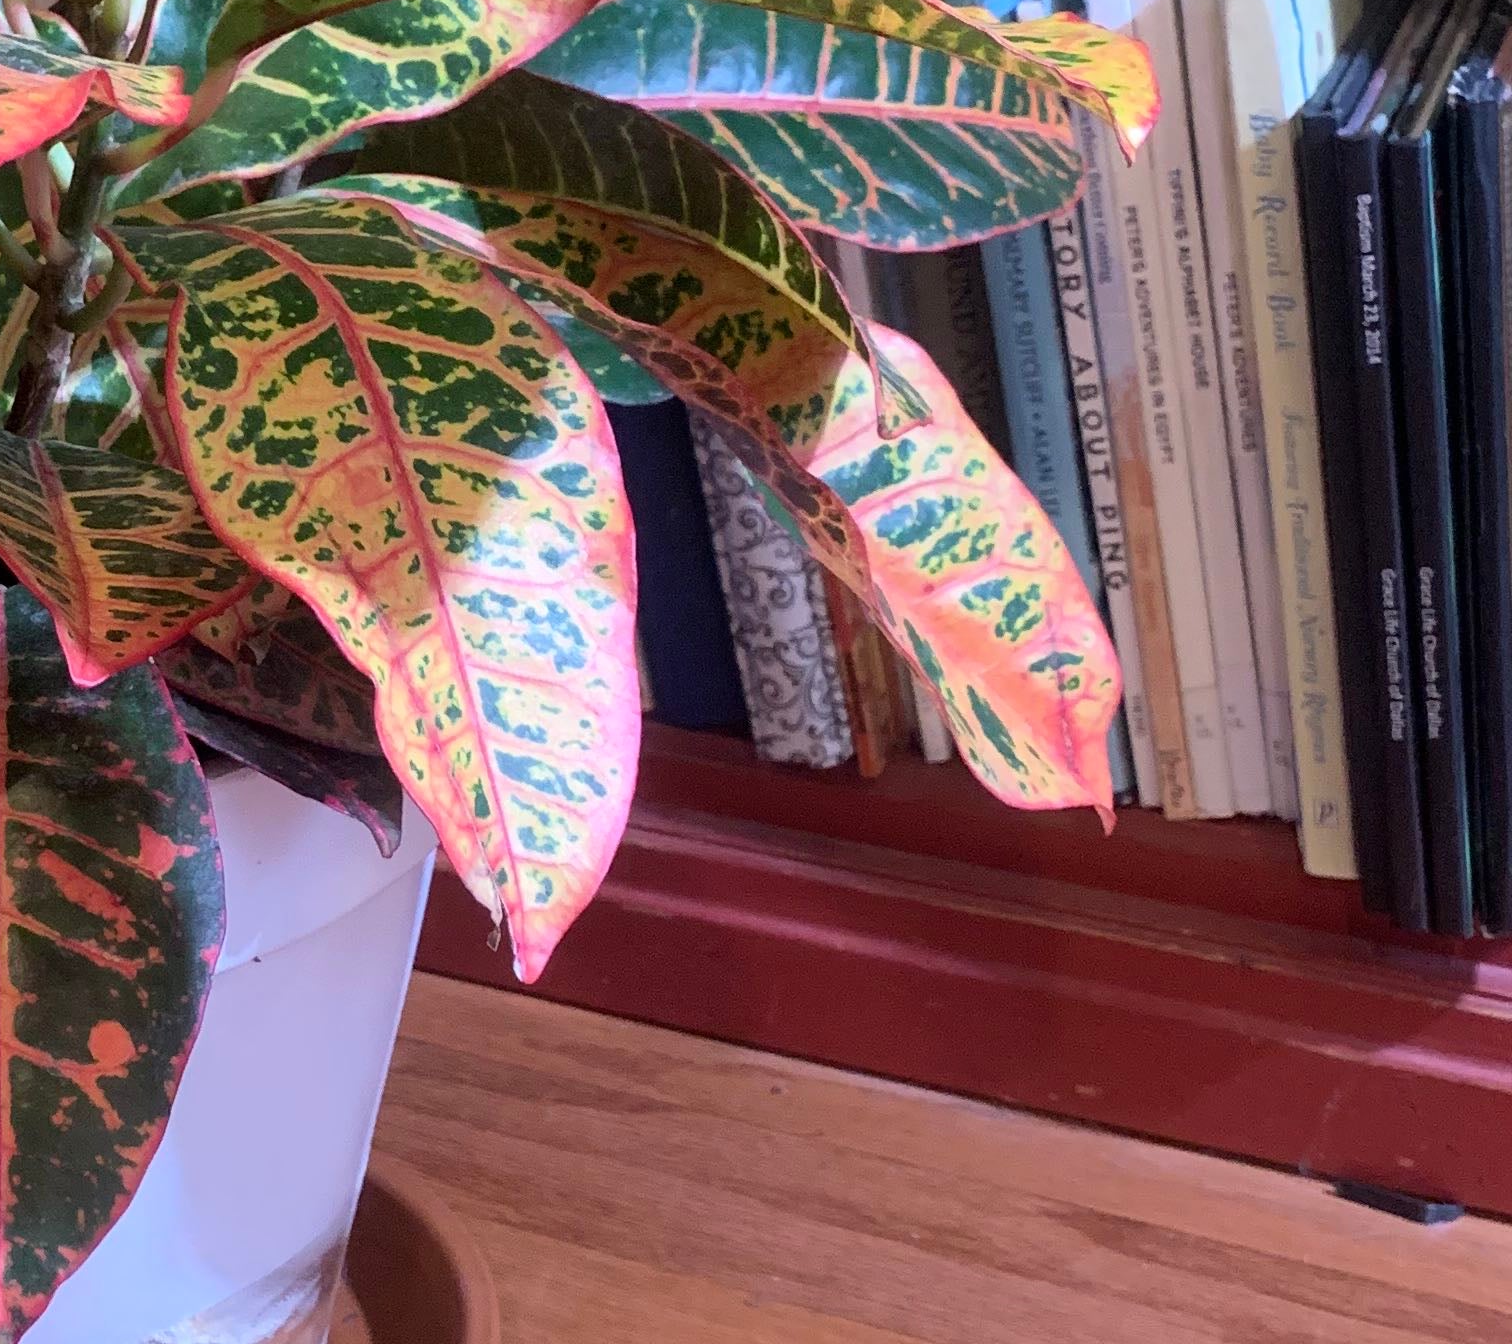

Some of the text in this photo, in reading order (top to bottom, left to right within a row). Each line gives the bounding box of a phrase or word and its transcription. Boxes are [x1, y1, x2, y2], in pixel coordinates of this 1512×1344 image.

[1247, 111, 1283, 179] Baby
[1176, 245, 1201, 328] ALPHABET
[1251, 192, 1294, 280] Record
[1356, 194, 1383, 365] Baptism March 23, 2014
[1051, 216, 1130, 593] TORY ABOUT PING
[1124, 205, 1174, 465] PETER'S ADVENTURES IN EGYPT
[1188, 332, 1211, 391] HOUSE
[1222, 271, 1257, 453] PETER'S ADVENTURES
[1266, 290, 1302, 354] Book
[1381, 568, 1405, 741] Grace Life Church of Dallas
[1419, 566, 1444, 739] Grace Life Church of Dallas
